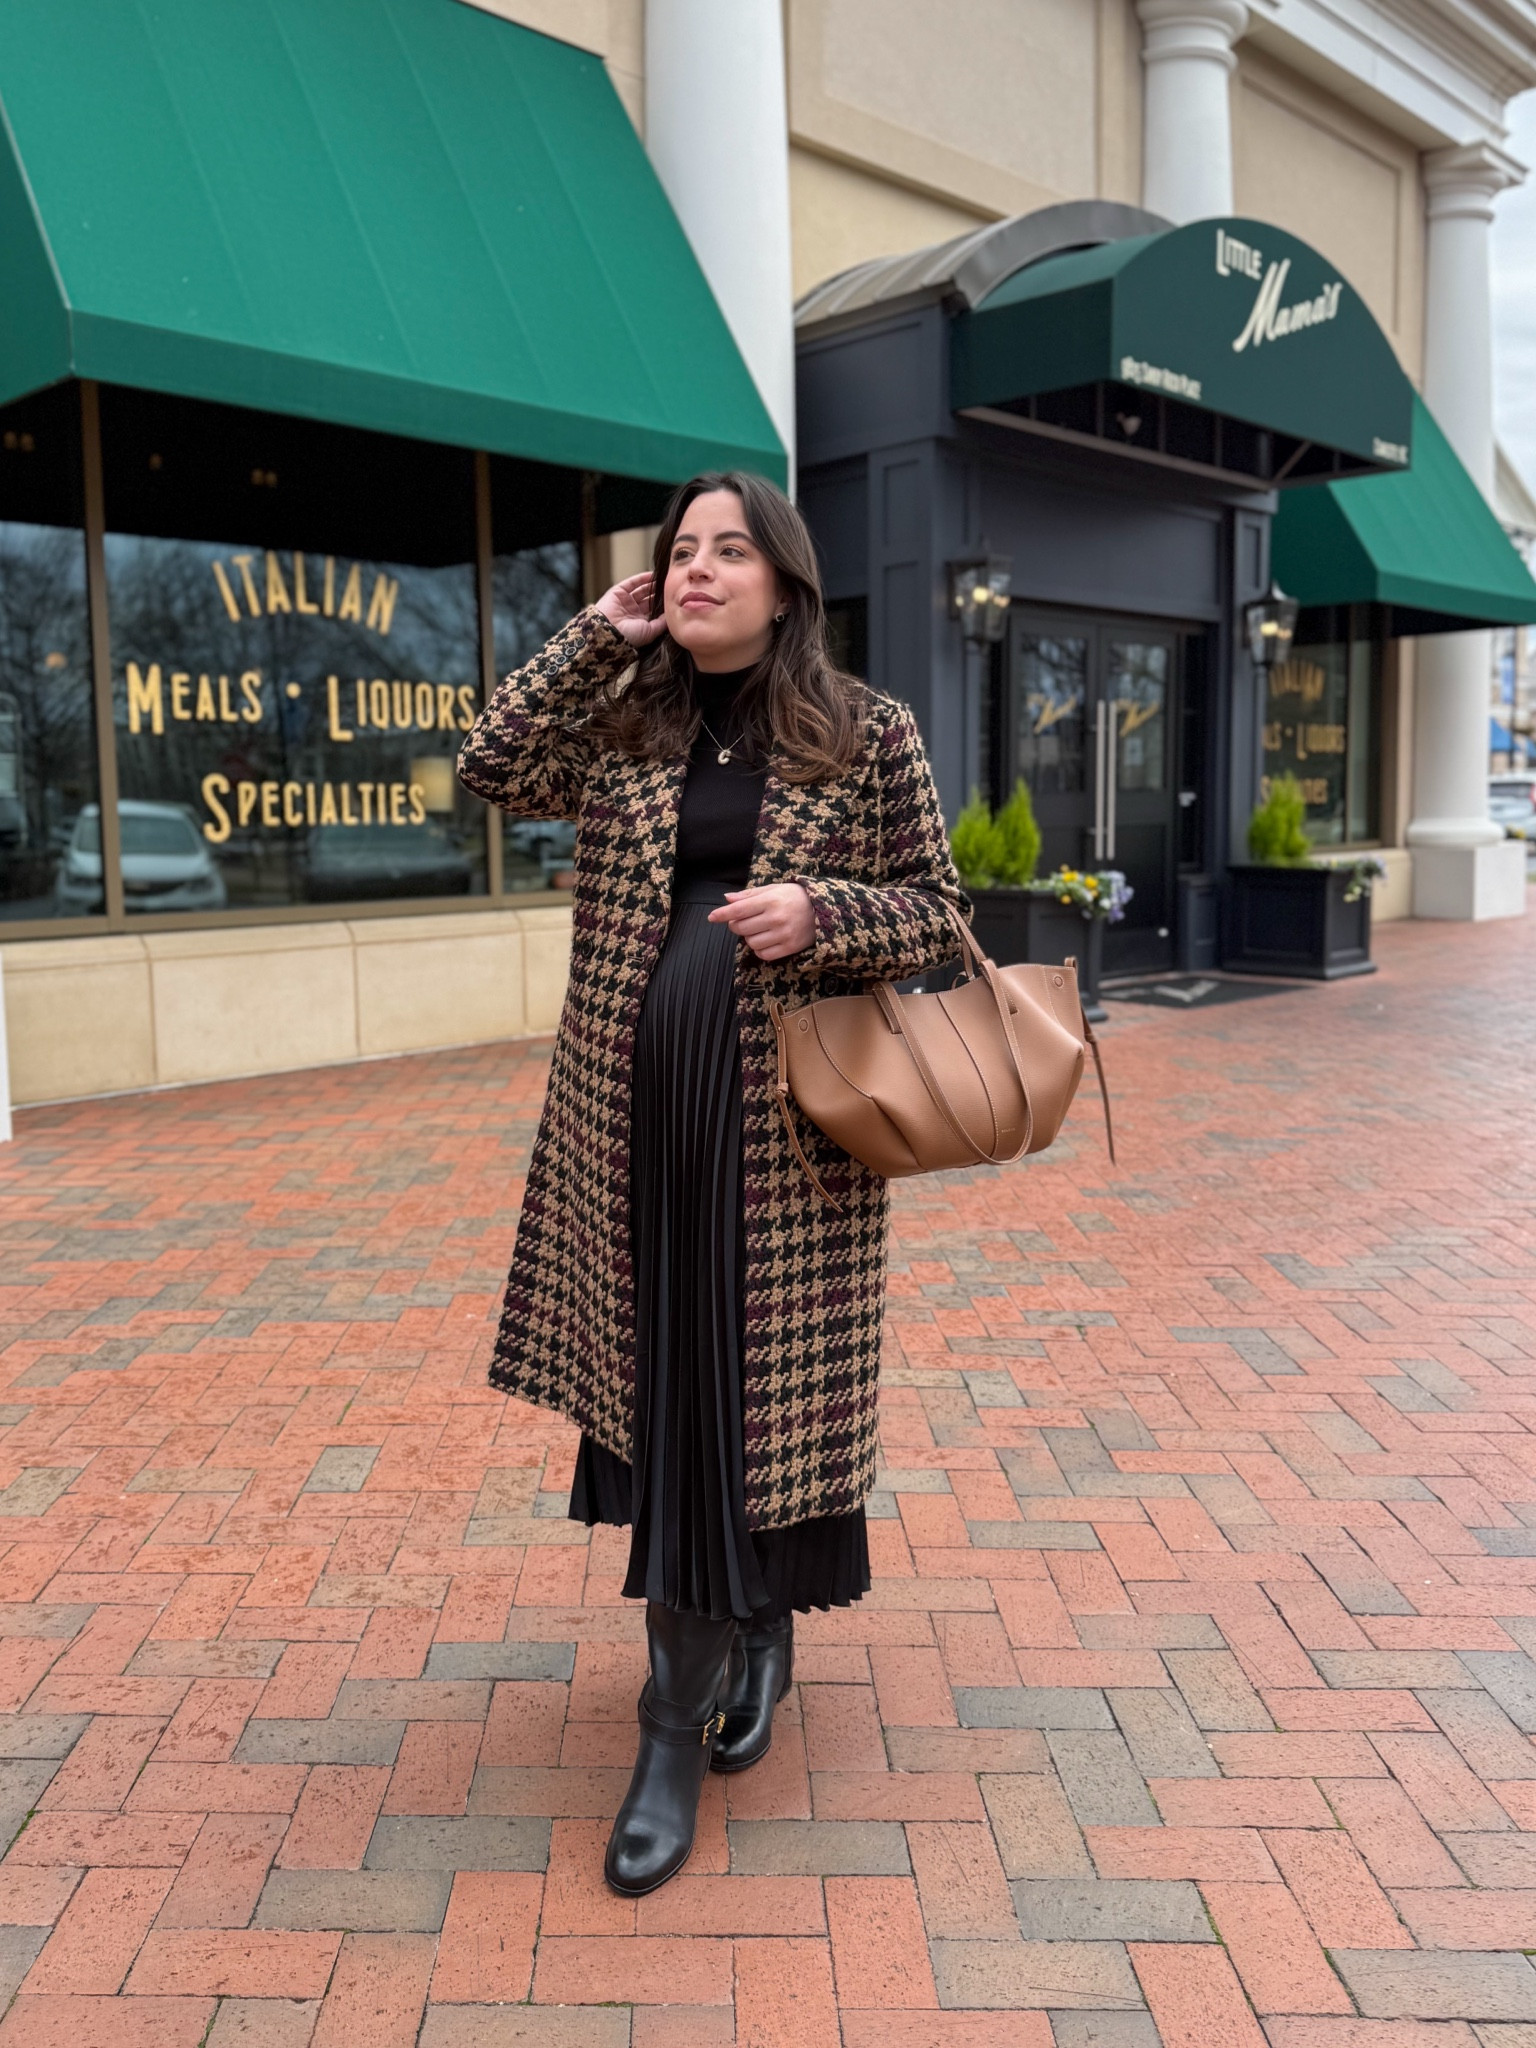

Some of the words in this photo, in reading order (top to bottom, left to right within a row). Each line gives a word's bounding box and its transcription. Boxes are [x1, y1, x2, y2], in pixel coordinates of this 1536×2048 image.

[1233, 258, 1343, 352] Mama's
[212, 551, 399, 635] ITALIAN
[126, 662, 263, 735] MEALS
[327, 675, 476, 741] LIQUORS
[202, 773, 427, 844] SPECIALTIES
